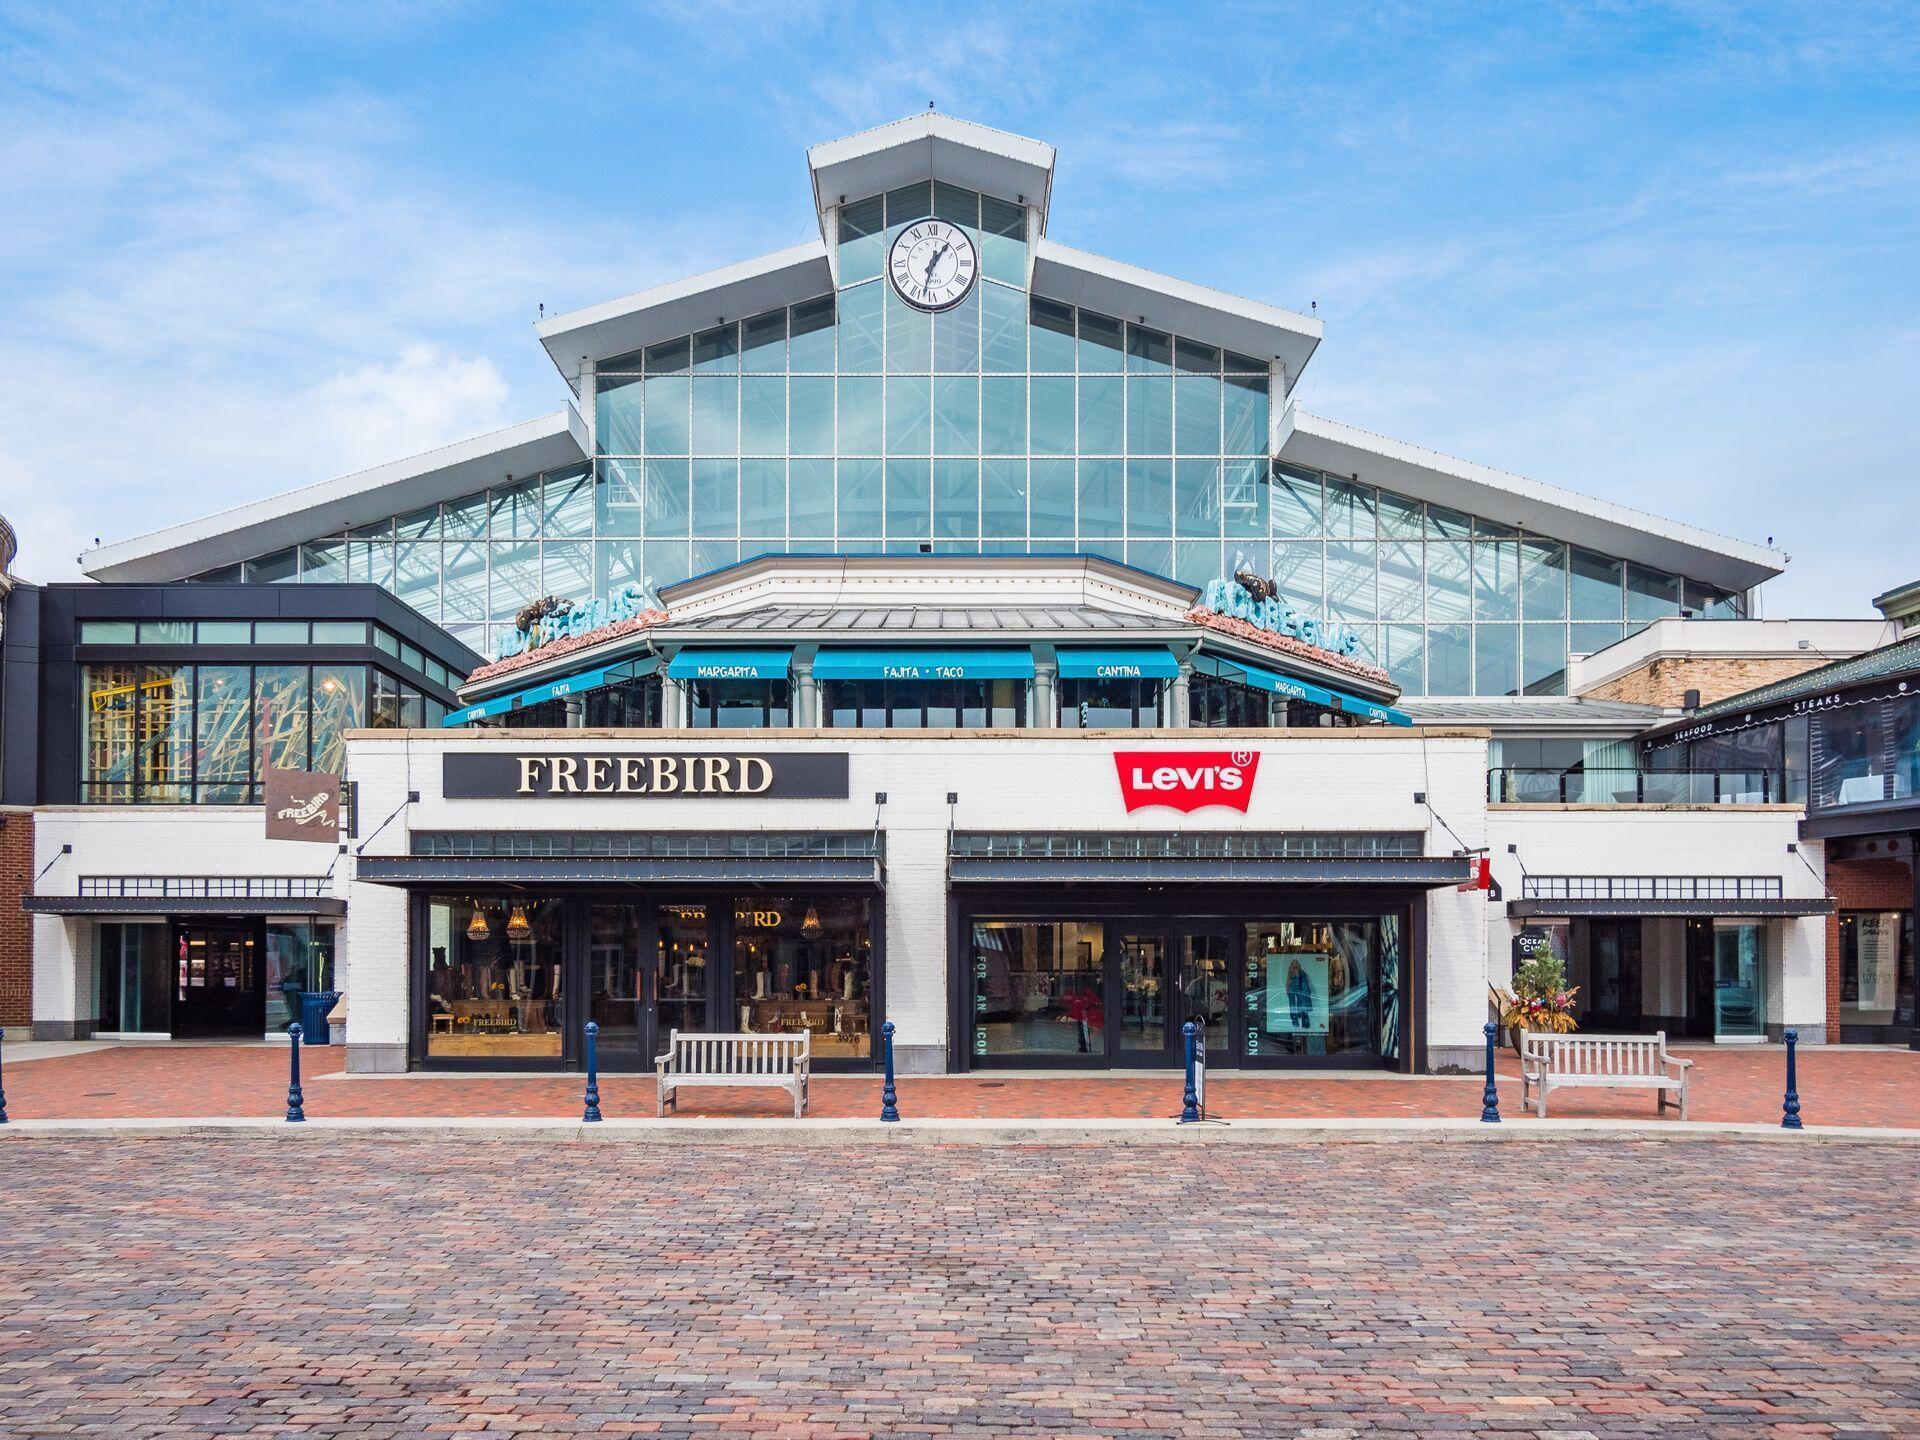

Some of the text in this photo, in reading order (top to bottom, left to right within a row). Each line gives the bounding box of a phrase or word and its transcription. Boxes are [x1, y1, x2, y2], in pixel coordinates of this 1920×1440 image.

[697, 665, 759, 679] MARGARITA
[883, 665, 965, 679] FAJITA TACO
[1096, 665, 1142, 678] CANTINA
[551, 683, 570, 697] FAJITA
[1274, 680, 1306, 699] MARGARITA
[1793, 694, 1841, 711] STEAKS
[1674, 724, 1713, 740] SEAFOOD
[516, 757, 774, 793] FREEBIRD
[277, 792, 330, 820] FREEBIRD
[976, 956, 987, 979] FOR
[1248, 956, 1258, 979] FOR
[976, 995, 987, 1011] AN
[1248, 995, 1258, 1011] AN
[473, 1018, 517, 1026] FREEBIRD
[976, 1027, 987, 1056] ICON
[1248, 1027, 1258, 1056] ICON
